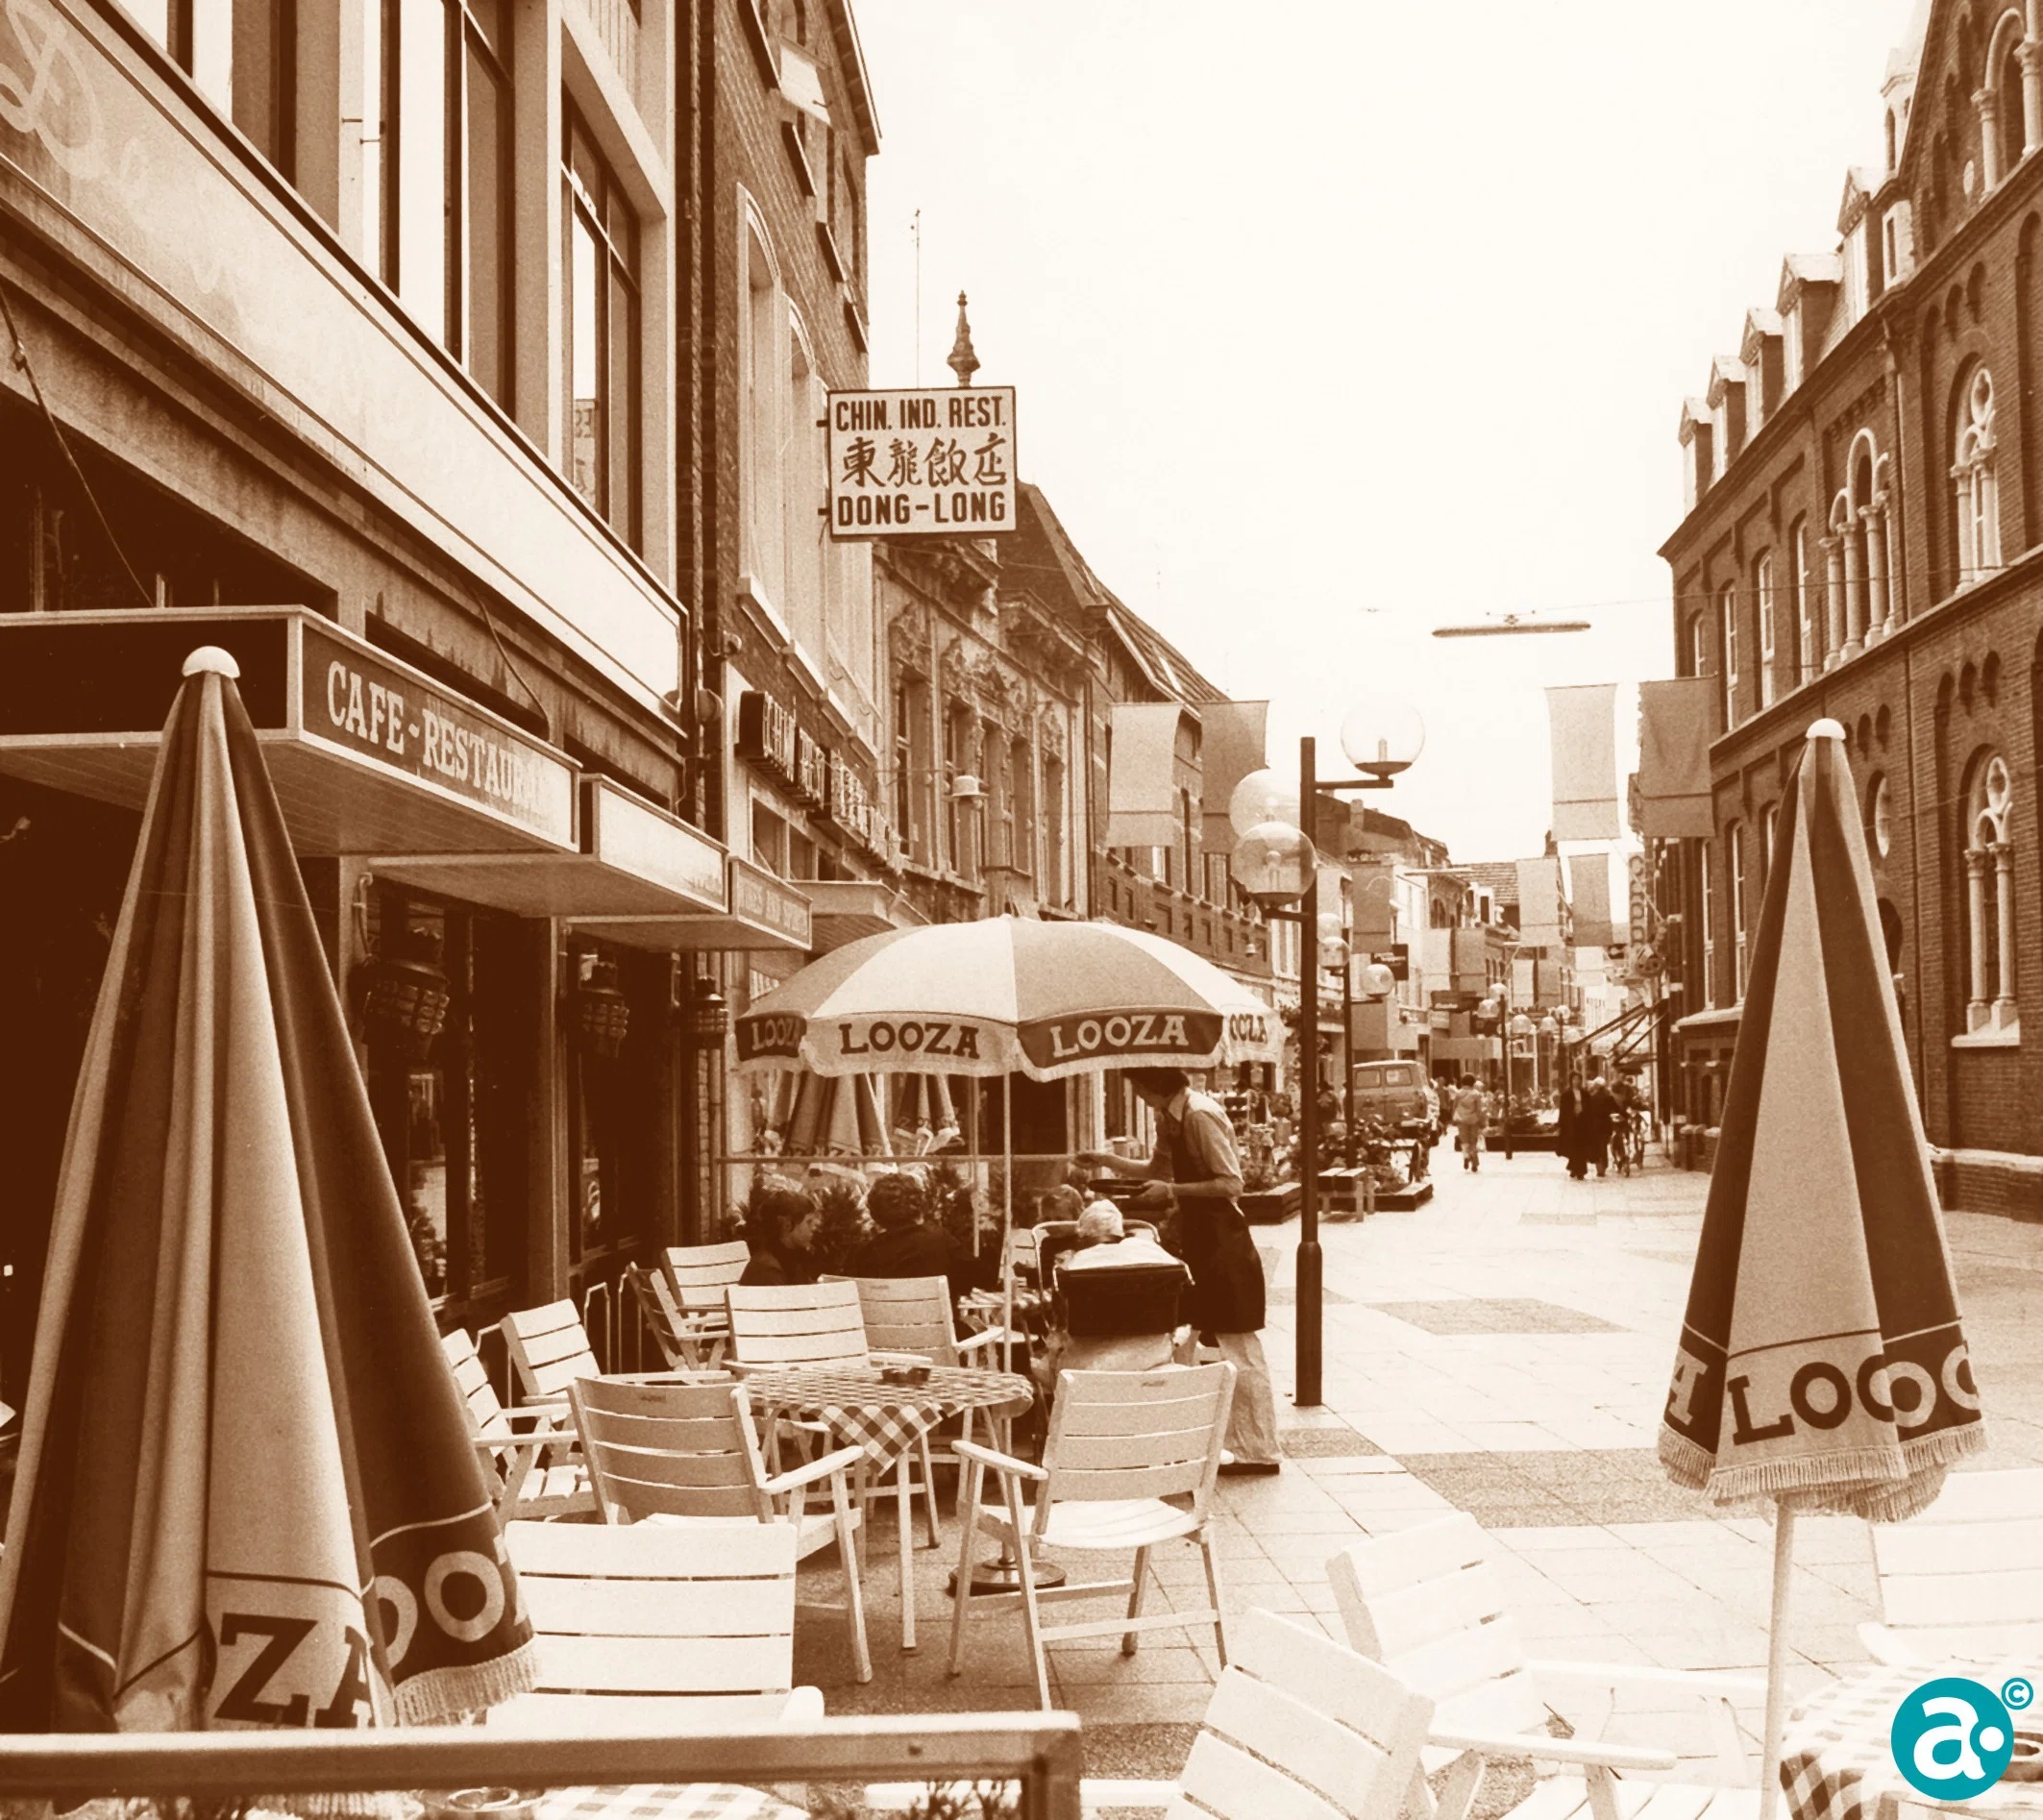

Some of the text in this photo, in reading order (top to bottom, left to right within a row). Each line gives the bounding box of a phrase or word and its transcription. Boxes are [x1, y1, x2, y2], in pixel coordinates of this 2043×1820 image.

[836, 396, 1007, 431] CHIN. IND. REST.
[837, 491, 1006, 527] DONG-LONG
[328, 660, 557, 819] CAFE-RESTAURA
[838, 1021, 980, 1060] LOOZA
[1049, 1014, 1190, 1058] LOOZA
[1229, 1013, 1268, 1045] OOZA
